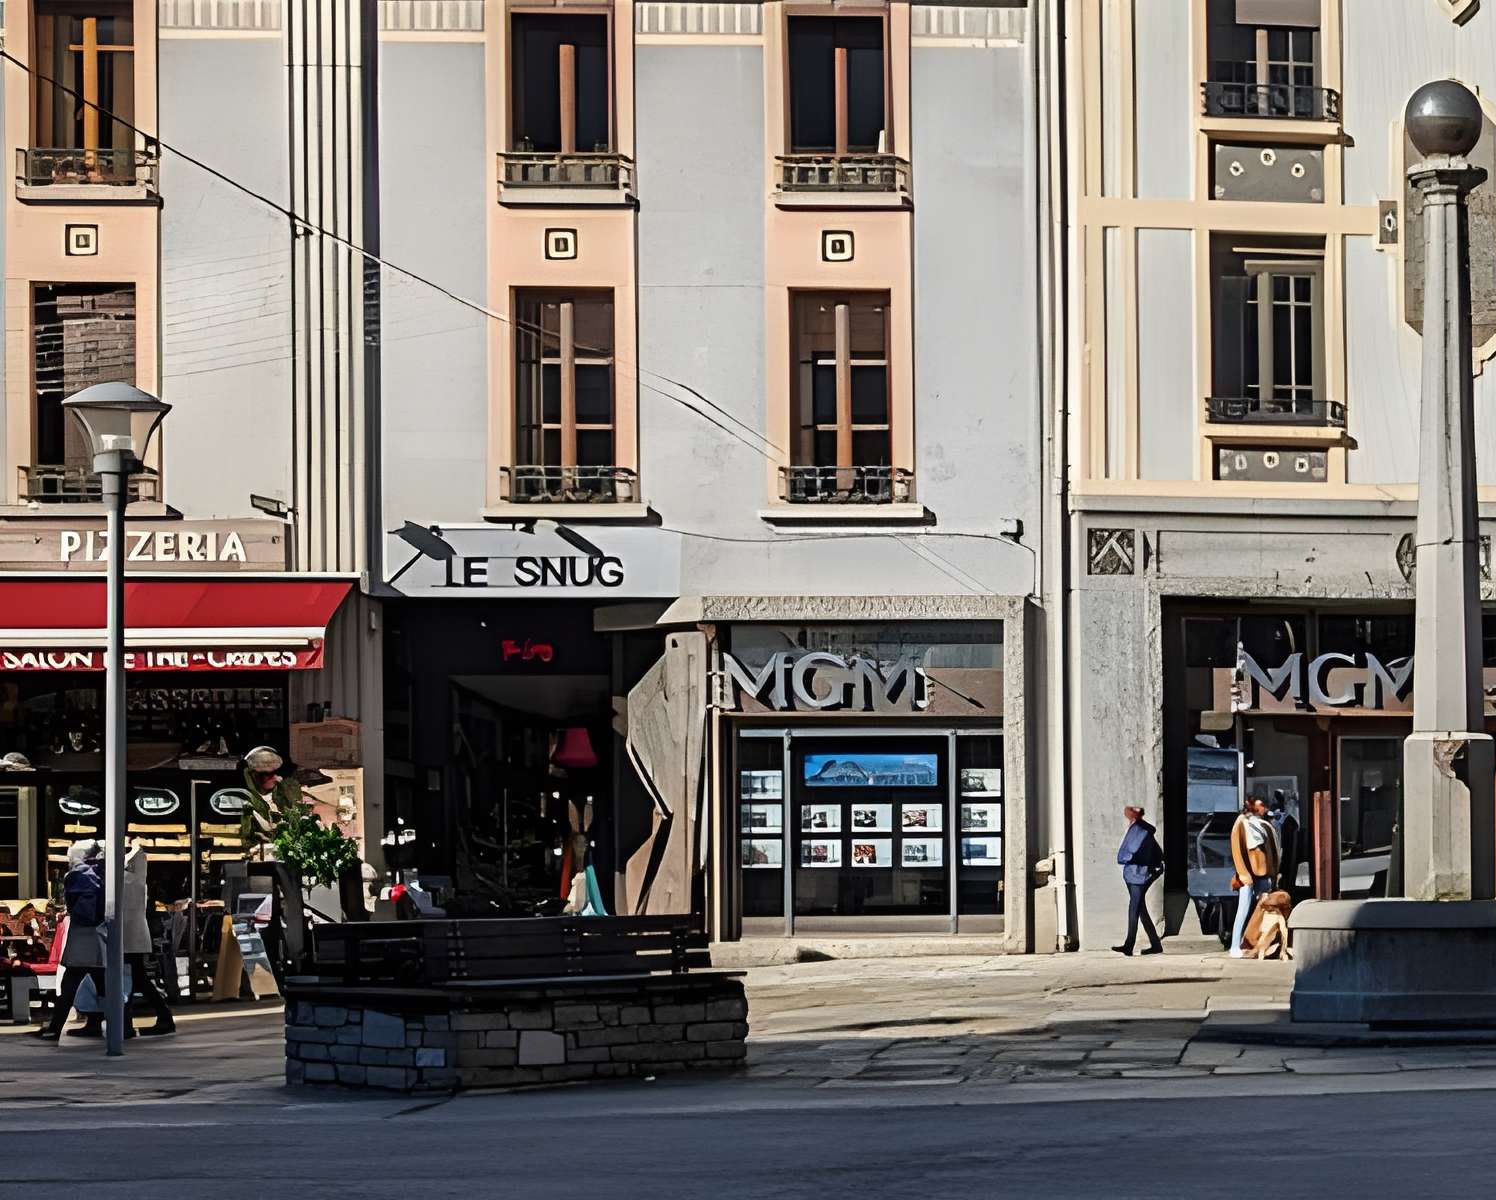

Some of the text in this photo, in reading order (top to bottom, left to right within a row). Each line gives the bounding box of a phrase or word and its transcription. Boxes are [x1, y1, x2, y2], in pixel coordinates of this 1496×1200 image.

[445, 556, 624, 587] LE SNUG
[722, 650, 926, 711] MGM
[1239, 651, 1415, 711] MGM
